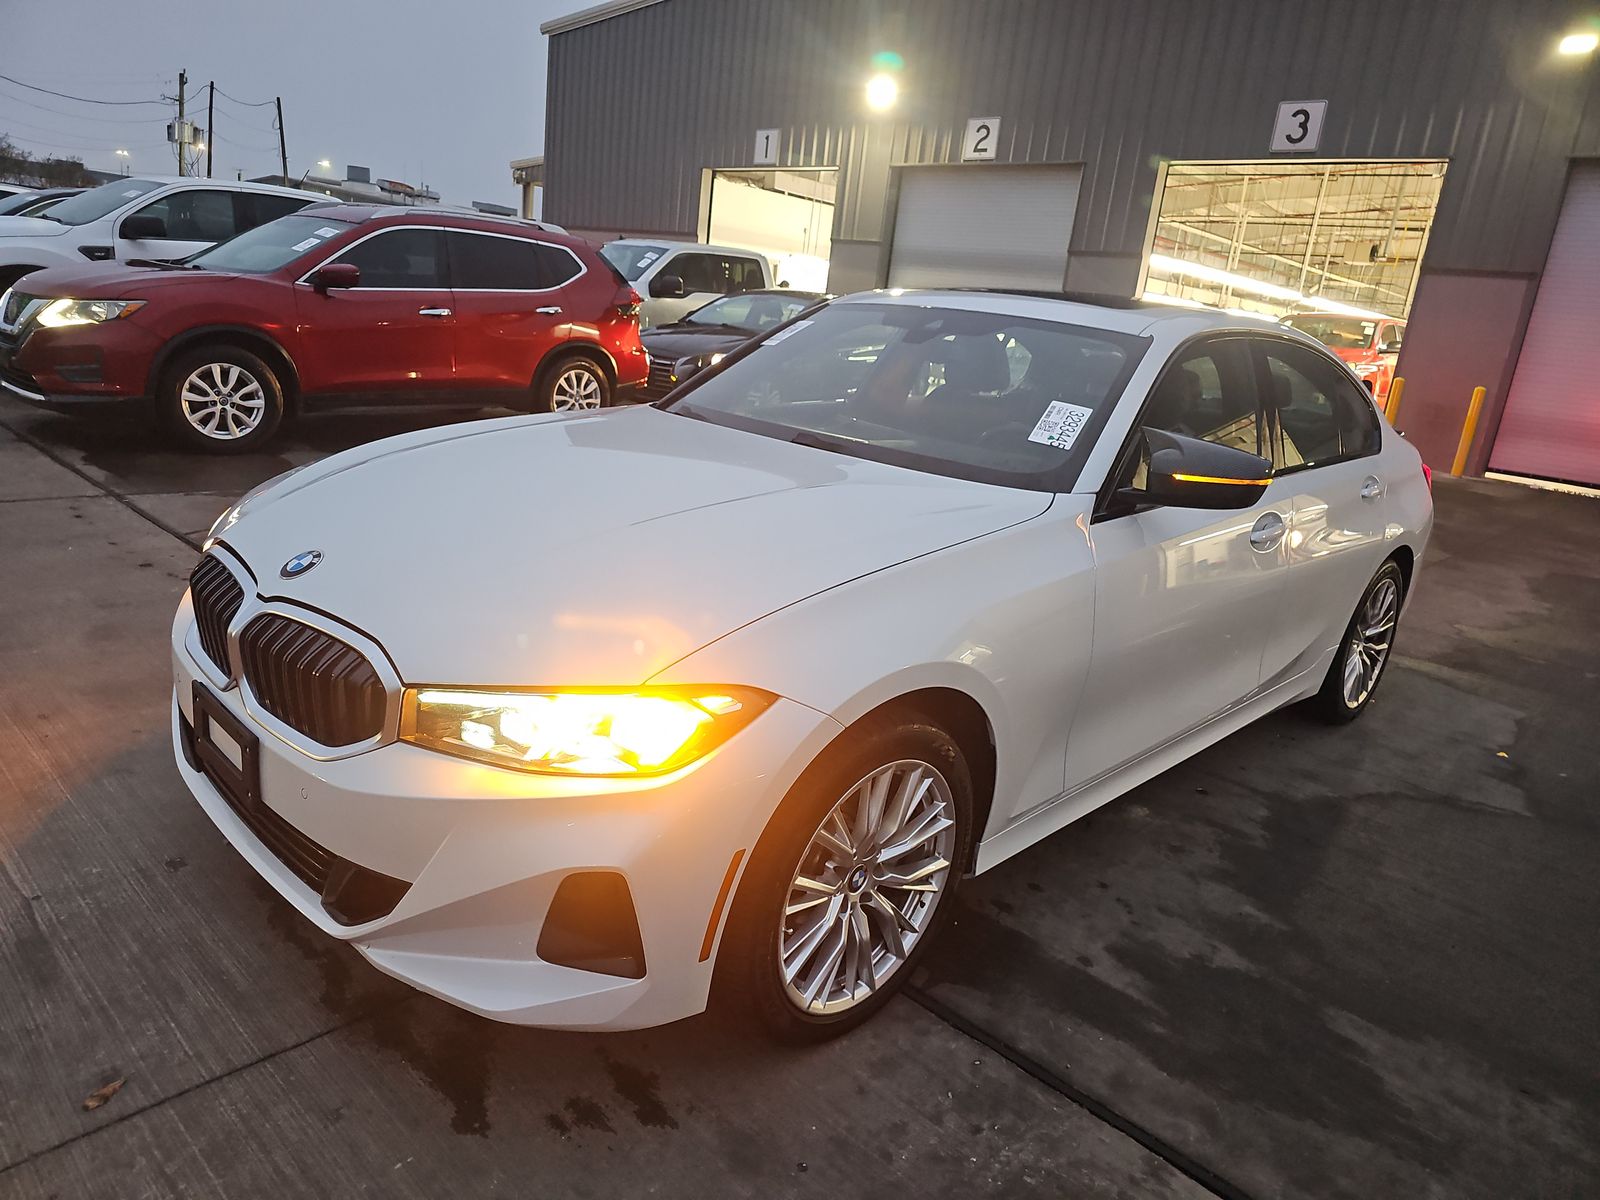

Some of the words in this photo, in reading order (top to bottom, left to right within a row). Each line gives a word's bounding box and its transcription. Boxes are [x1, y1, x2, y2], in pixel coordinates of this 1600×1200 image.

[973, 124, 990, 153] 2
[1286, 109, 1310, 144] 3
[765, 135, 770, 159] 1
[1050, 410, 1085, 449] 3293445
